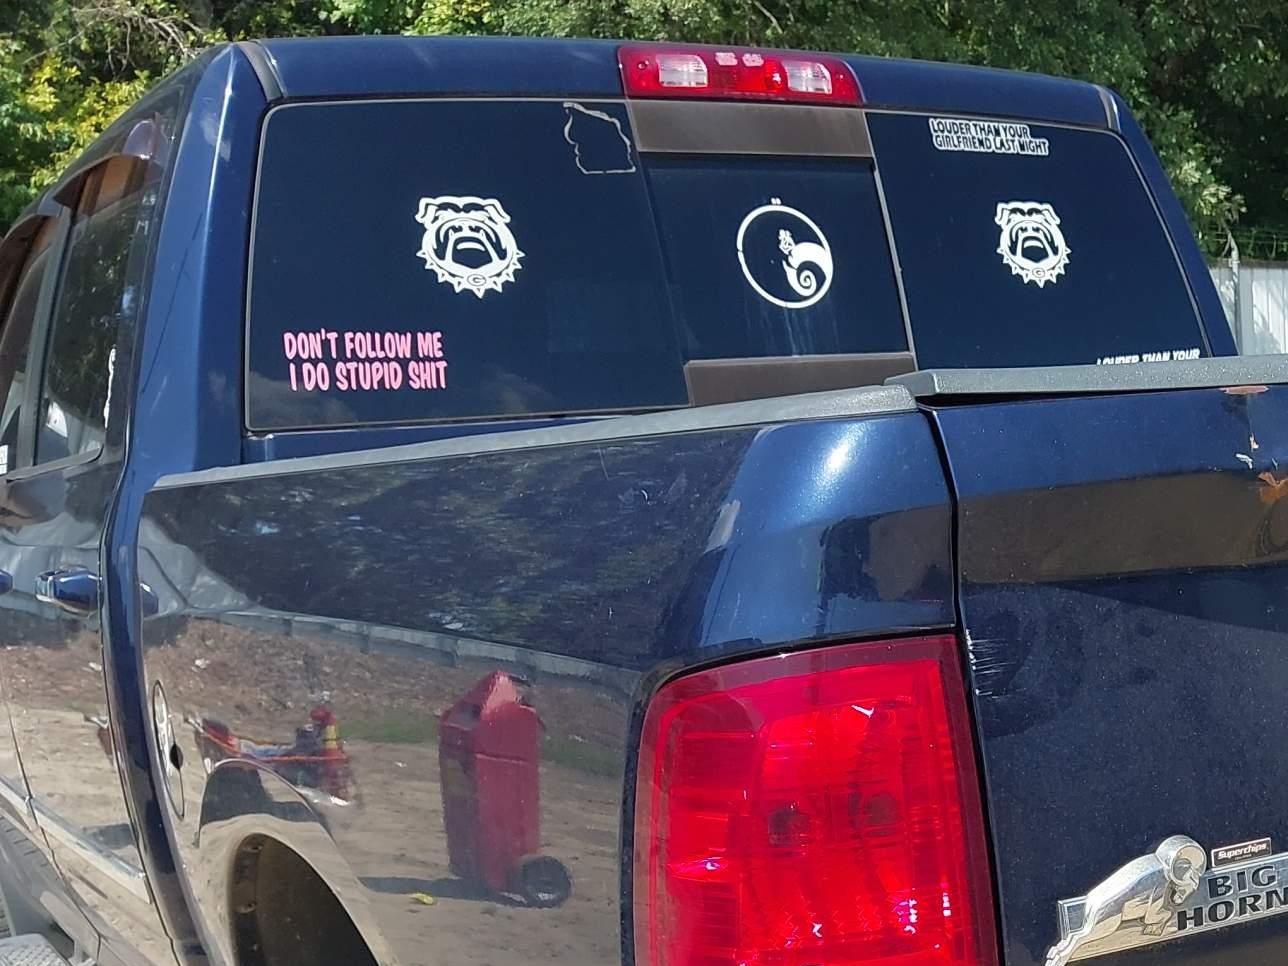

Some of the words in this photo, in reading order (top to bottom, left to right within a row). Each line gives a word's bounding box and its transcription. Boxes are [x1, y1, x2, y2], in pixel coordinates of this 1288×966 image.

[930, 119, 973, 136] LOUDER
[972, 121, 1001, 138] THAN
[1001, 124, 1030, 140] YOUR
[934, 134, 992, 151] GIRLFRIEND
[993, 137, 1017, 152] LAST
[1018, 139, 1048, 154] NIGHT
[283, 328, 338, 360] DON'T
[344, 332, 412, 359] FOLLOW
[417, 332, 444, 359] ME
[1142, 350, 1171, 363] THAN
[1172, 347, 1201, 361] YOUR
[289, 362, 298, 392] I
[302, 362, 330, 392] DO
[335, 361, 403, 391] STUPID
[408, 360, 448, 389] SHIT
[1217, 842, 1268, 860] Superchips
[1207, 865, 1278, 899] BIG
